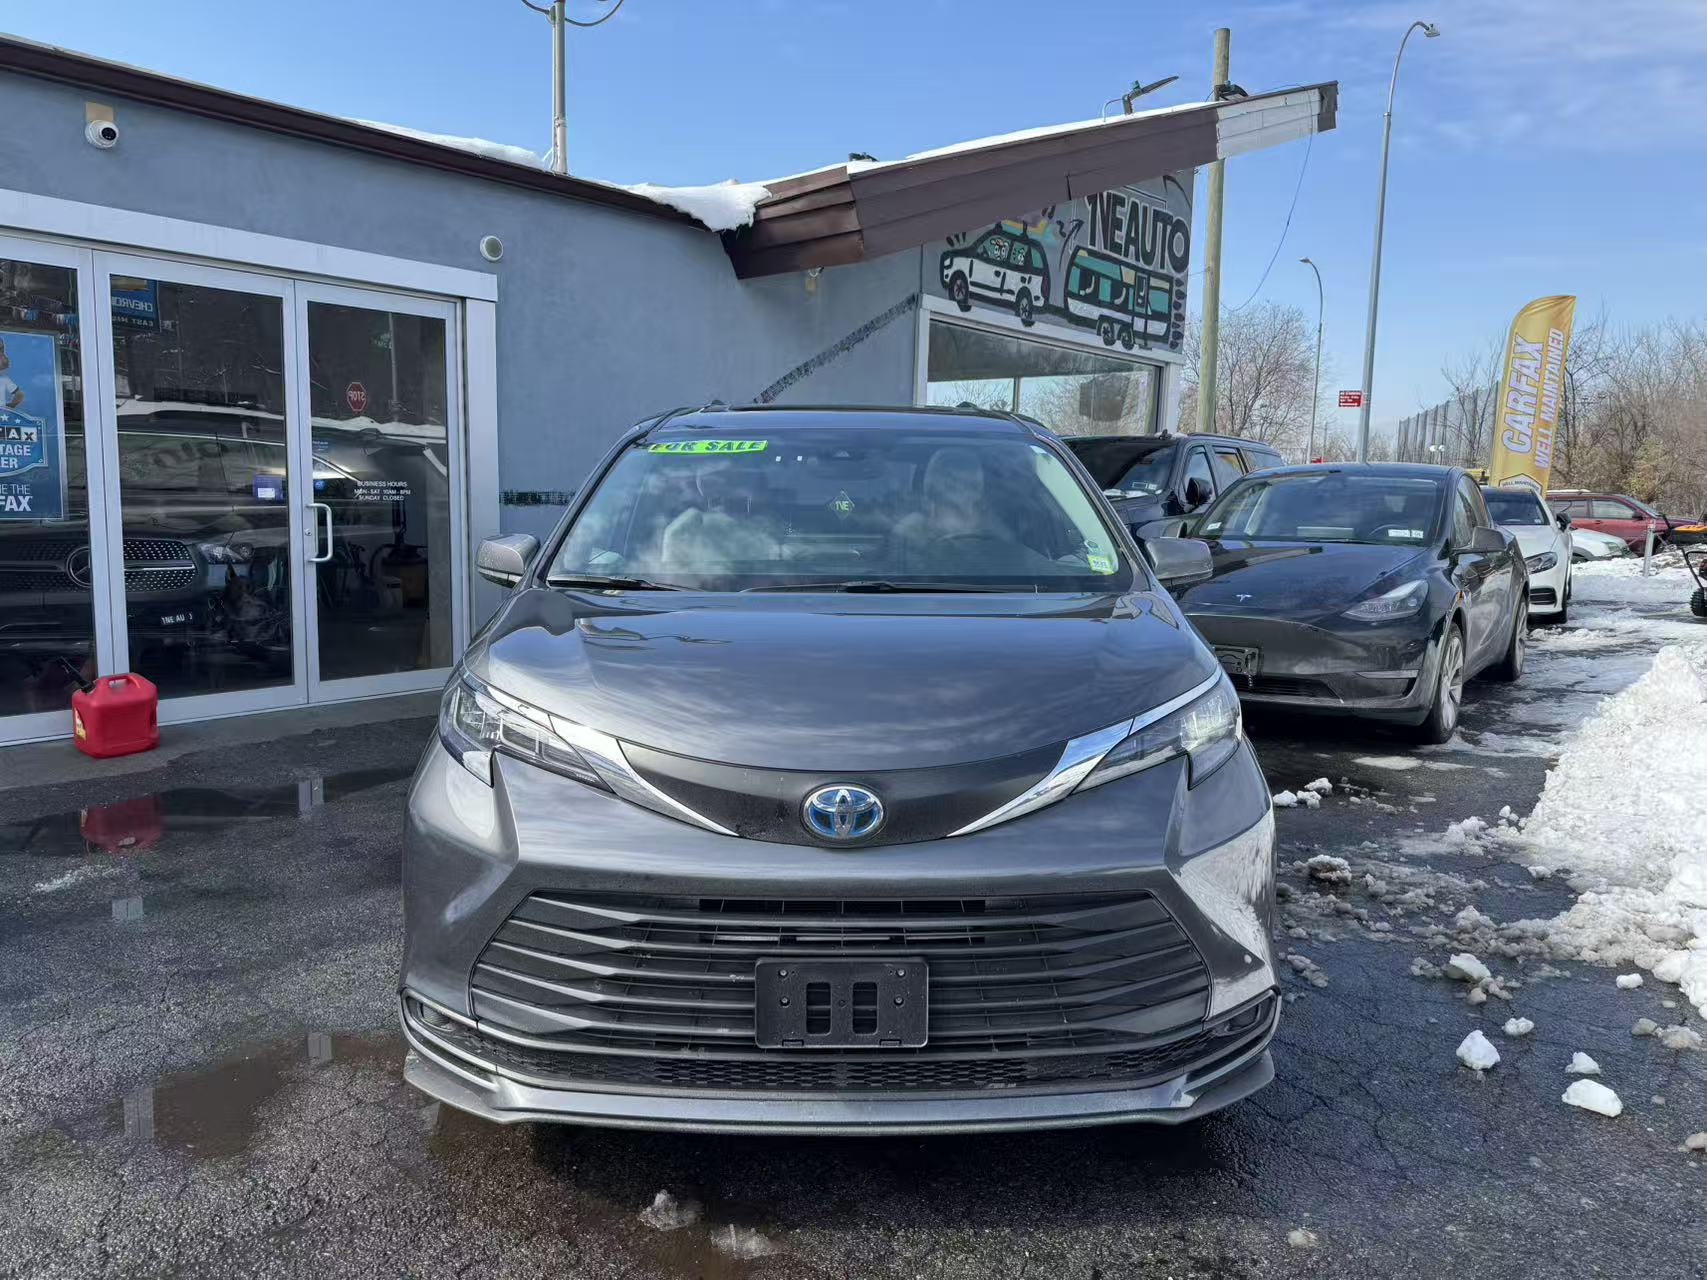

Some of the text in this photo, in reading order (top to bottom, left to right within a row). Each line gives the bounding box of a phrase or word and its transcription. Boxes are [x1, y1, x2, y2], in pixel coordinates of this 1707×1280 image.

[1502, 332, 1544, 454] CARFAX
[1535, 327, 1565, 469] WELL MAINTAINED
[0, 427, 35, 441] AX
[650, 440, 762, 452] FOR SALE
[0, 484, 31, 494] E THE
